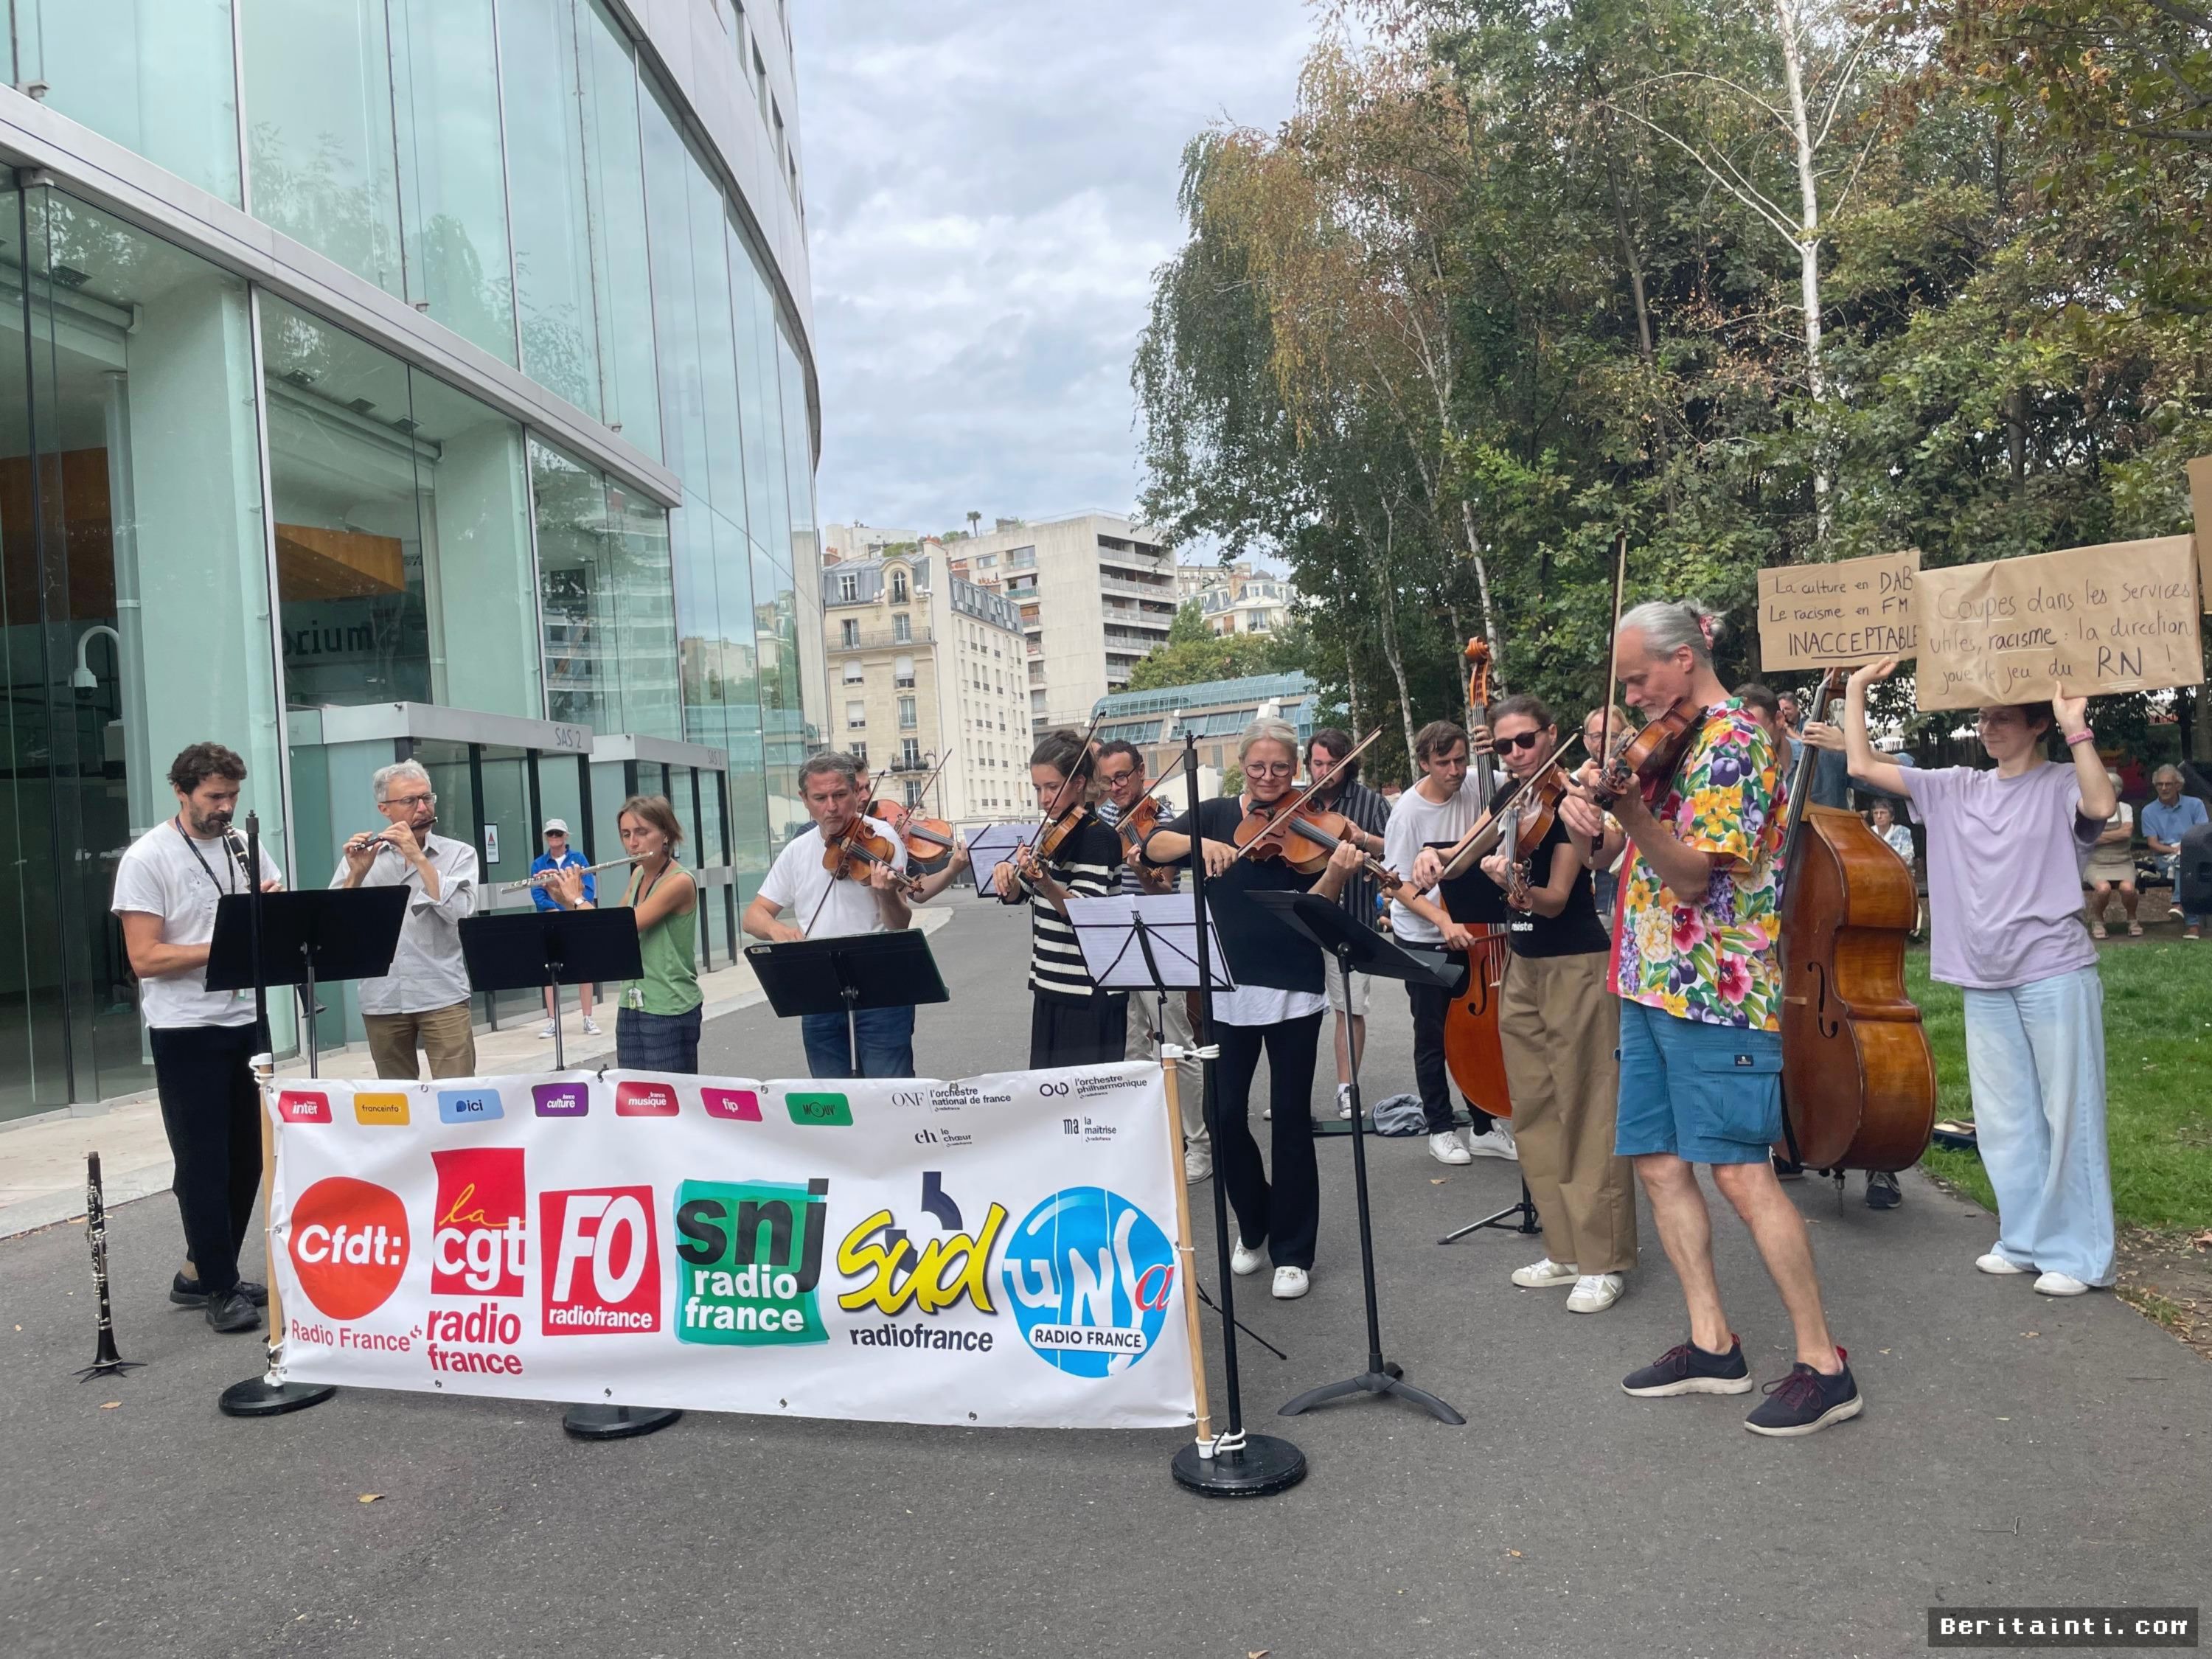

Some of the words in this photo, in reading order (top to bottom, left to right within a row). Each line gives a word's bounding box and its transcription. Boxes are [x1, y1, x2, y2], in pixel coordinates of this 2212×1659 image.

[1775, 576, 1795, 594] La
[1801, 580, 1846, 594] culture
[1854, 581, 1868, 589] en
[1879, 566, 1913, 594] DAB
[1770, 605, 1787, 622] Le
[1794, 607, 1846, 620] racisme
[1856, 607, 1869, 616] en
[1882, 597, 1908, 614] FM
[1938, 587, 2017, 627] Coupes
[2027, 586, 2075, 613] dans
[2085, 579, 2107, 605] les
[2121, 581, 2191, 602] services
[1789, 625, 1917, 656] INACCEPTABLE
[1989, 627, 2057, 650] racisme
[2079, 617, 2099, 640] la
[2110, 610, 2193, 638] direction
[1942, 668, 1974, 695] joue
[1984, 660, 1996, 680] le
[2004, 658, 2032, 695] jeu
[2048, 658, 2073, 678] du
[2097, 646, 2142, 678] RN
[555, 727, 573, 747] SAS
[576, 731, 582, 748] 2
[1075, 1075, 1123, 1086] l'orchestre
[1077, 1079, 1147, 1094] philharmonique
[546, 1098, 576, 1108] culture
[628, 1096, 667, 1107] musique
[892, 1092, 924, 1107] ONF
[930, 1088, 978, 1098] l'orchestre
[932, 1096, 967, 1105] national
[970, 1095, 981, 1105] de
[983, 1094, 1012, 1104] france
[292, 1101, 318, 1114] inter
[467, 1099, 484, 1112] ici
[722, 1098, 738, 1113] fip
[1063, 1119, 1079, 1135] ma
[1085, 1116, 1091, 1125] la
[1085, 1125, 1117, 1134] maîtrise
[439, 1183, 526, 1226] la
[675, 1178, 830, 1293] snj
[434, 1217, 526, 1291] cgt
[552, 1194, 648, 1304] FO
[695, 1264, 798, 1299] radio
[426, 1302, 521, 1346] radio
[549, 1305, 653, 1329] radiofrance
[685, 1297, 804, 1332] france
[292, 1318, 334, 1346] Radio
[849, 1324, 993, 1352] radiofrance
[1034, 1329, 1082, 1346] RADIO
[1087, 1331, 1142, 1348] FRANCE
[427, 1348, 524, 1376] france
